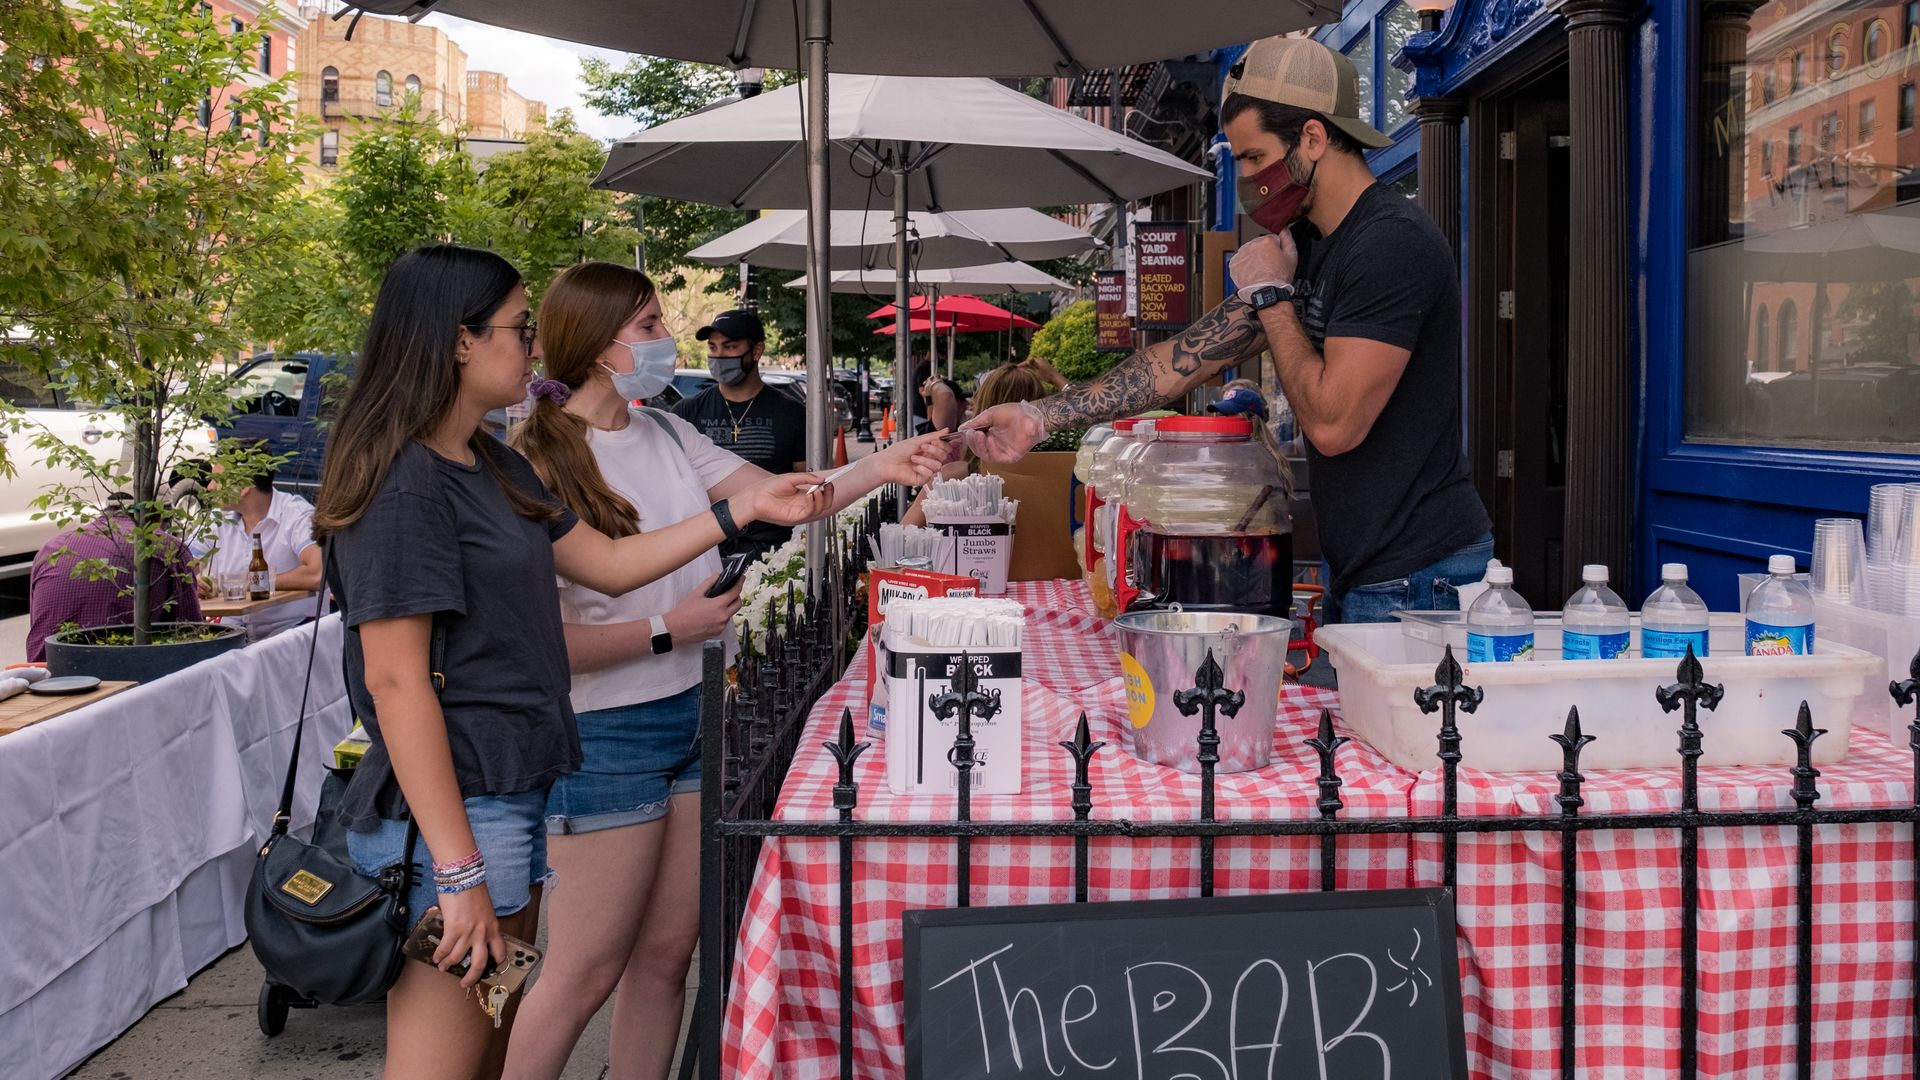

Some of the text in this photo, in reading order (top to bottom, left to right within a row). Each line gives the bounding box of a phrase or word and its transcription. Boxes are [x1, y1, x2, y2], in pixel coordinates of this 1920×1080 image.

[1141, 232, 1177, 242] COURT
[1141, 244, 1168, 254] YARD
[1141, 255, 1185, 266] SEATING
[1098, 276, 1115, 284] LATE
[1141, 274, 1172, 282] HEATED
[1098, 285, 1123, 293] NIGHT
[1141, 283, 1185, 292] BACKYARD
[1098, 293, 1121, 301] MENU
[1141, 293, 1164, 301] PATIO
[1141, 303, 1167, 311] NOW
[1141, 312, 1168, 321] OPEN!
[1099, 320, 1131, 328] SATURDAY
[1099, 330, 1118, 338] AFTER
[963, 538, 996, 546] Jumbo
[963, 547, 997, 555] Straws
[1751, 645, 1794, 656] CANADA
[949, 655, 990, 664] WRPPED
[946, 664, 994, 677] BCK
[929, 943, 1391, 1080] The BAR
